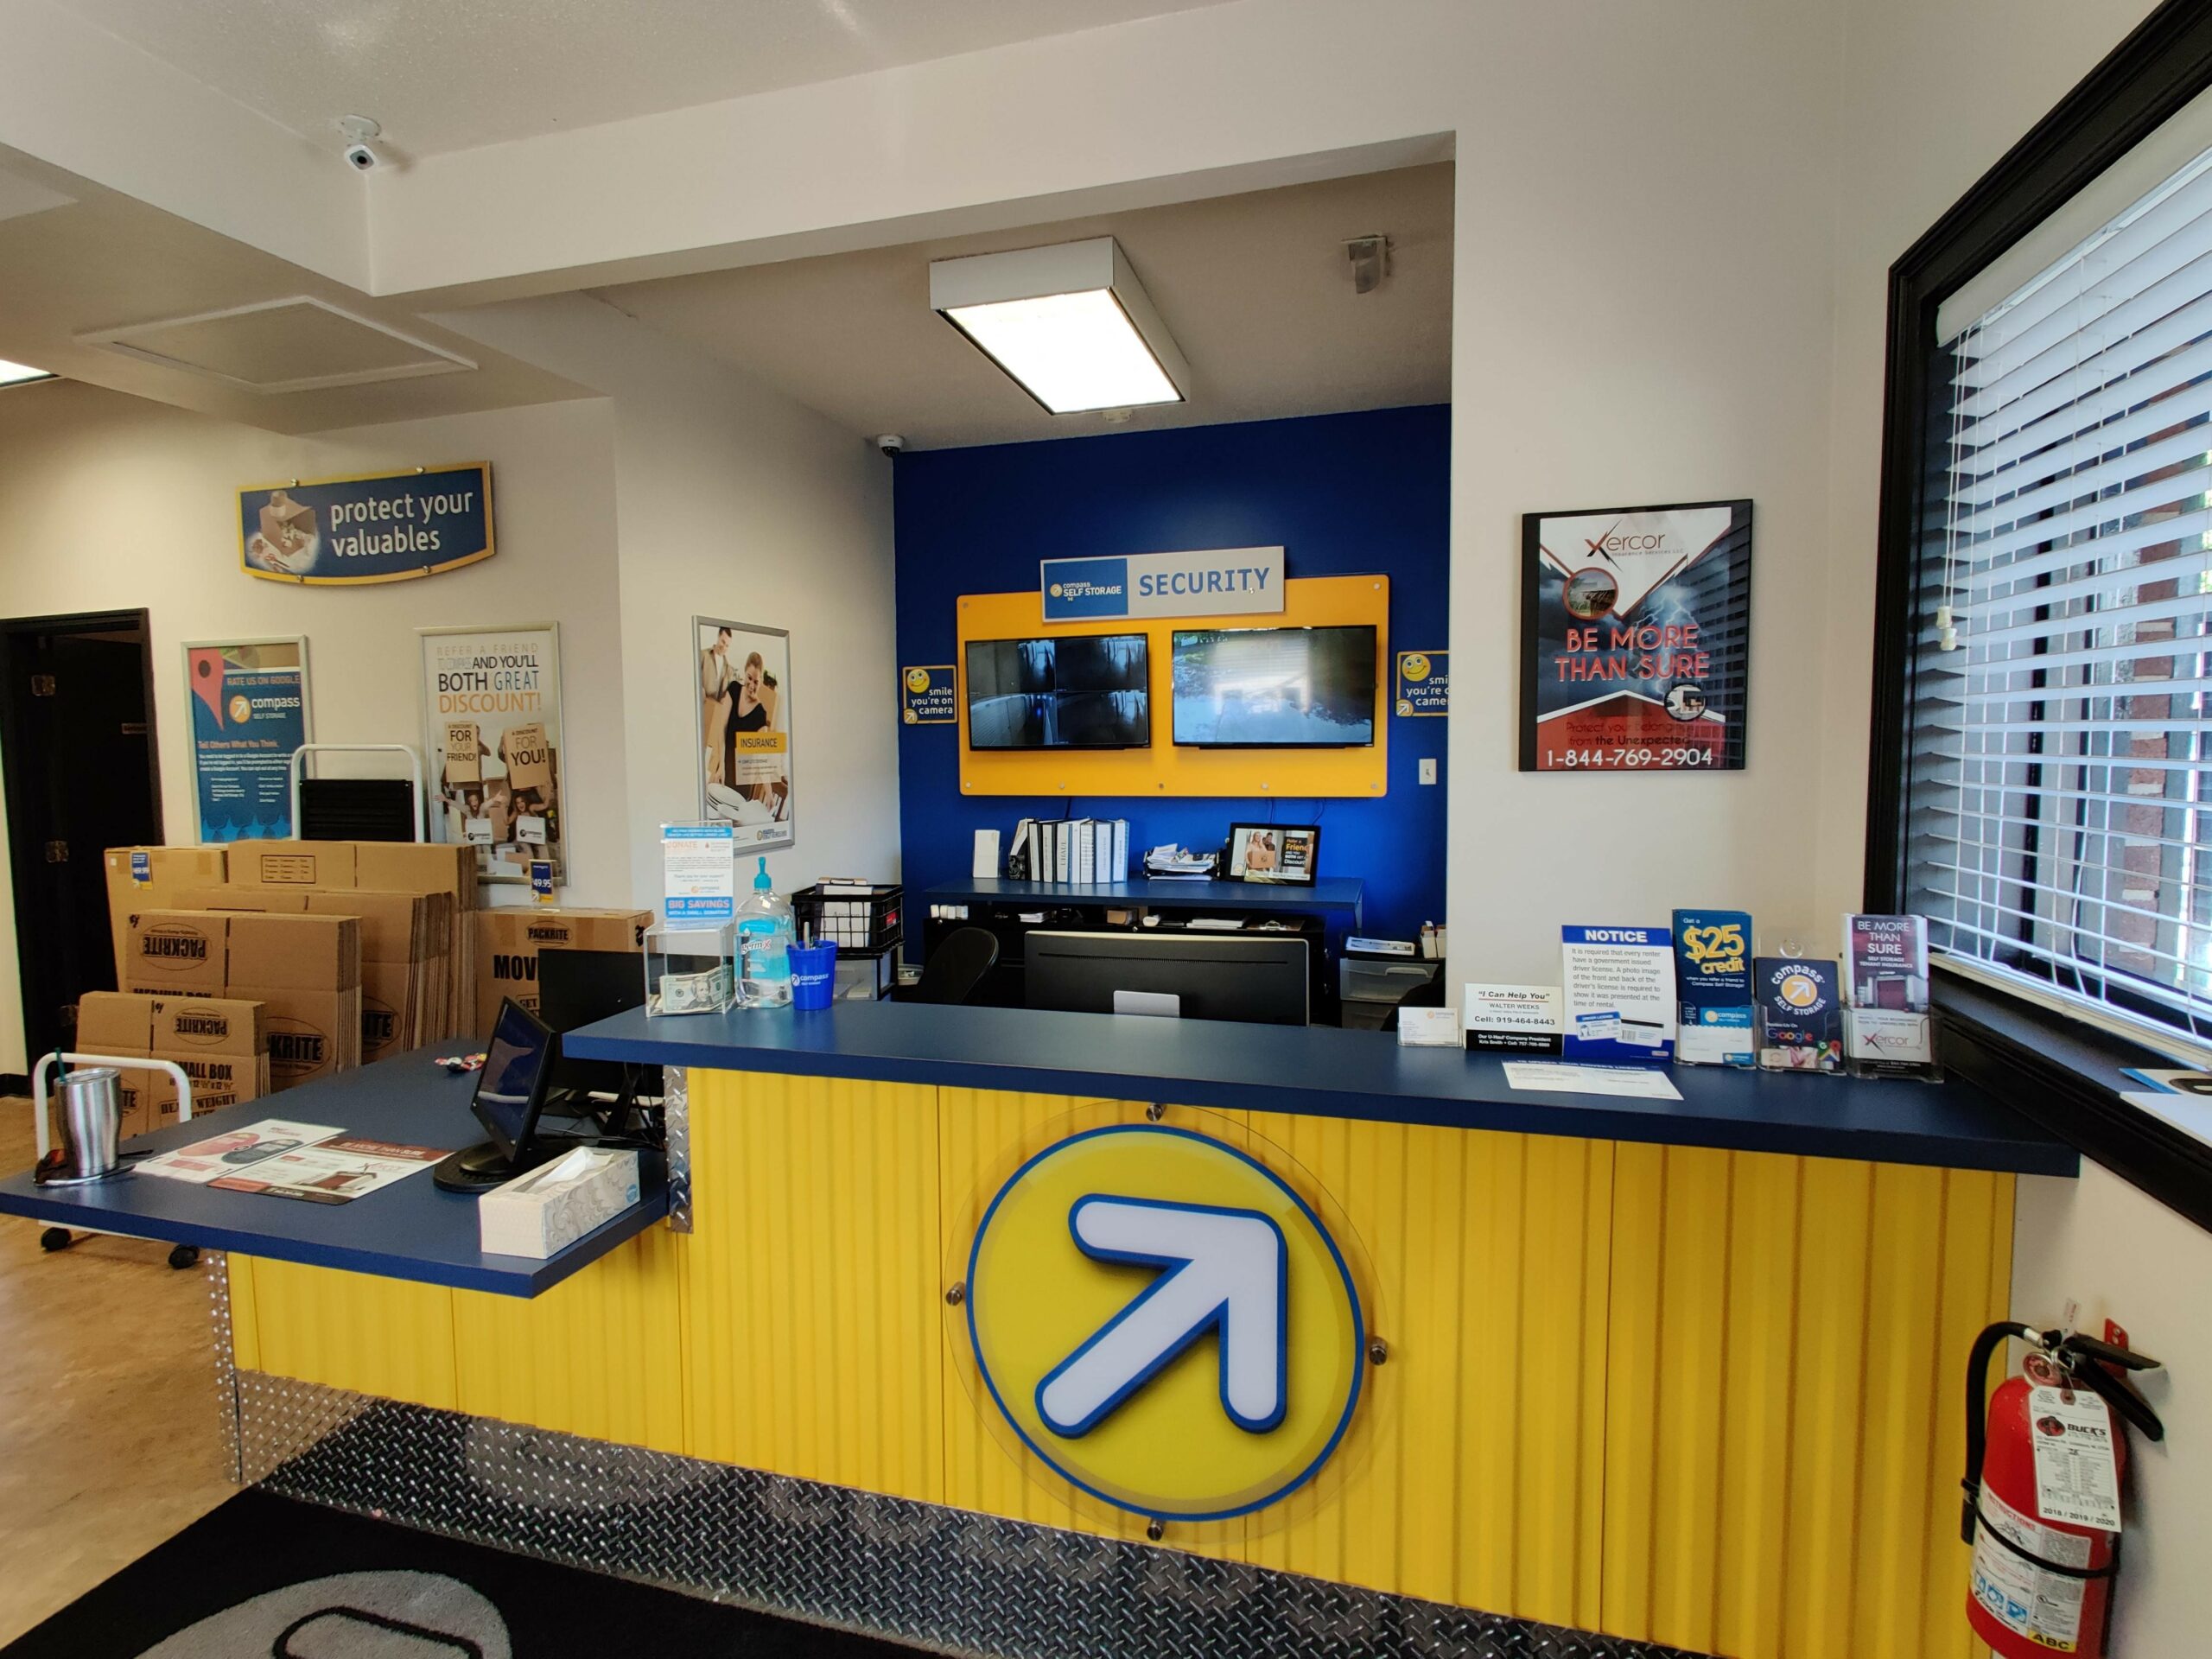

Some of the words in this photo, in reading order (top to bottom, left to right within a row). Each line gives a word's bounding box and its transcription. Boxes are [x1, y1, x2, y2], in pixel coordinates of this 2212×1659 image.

[330, 494, 415, 531] protect
[420, 492, 474, 524] your
[331, 524, 441, 556] valuables
[1585, 518, 1665, 572] Xercor
[1139, 567, 1270, 596] SECURITY
[1085, 586, 1122, 595] STORAGE
[1567, 628, 1599, 652] BE
[1611, 624, 1699, 651] MORE
[473, 656, 497, 669] AND
[499, 655, 538, 668] YOU'LL
[1554, 654, 1626, 683] THAN
[1638, 653, 1711, 680] SURE
[227, 677, 244, 685] RATE
[270, 675, 301, 684] GOOGLE
[439, 672, 487, 691] BOTH
[494, 671, 539, 690] GREAT
[1429, 675, 1448, 684] smi
[1406, 686, 1441, 697] you're
[251, 697, 300, 710] compass
[439, 692, 541, 713] DISCOUNT!
[911, 696, 940, 707] you're
[450, 730, 471, 741] FOR
[516, 736, 537, 748] FOR
[741, 738, 778, 748] INSURANCE
[1595, 736, 1613, 745] the
[511, 748, 546, 766] YOU!
[1548, 748, 1713, 767] 1-844-769-2904
[688, 899, 729, 909] SAVINGS
[1858, 921, 1871, 930] BE
[1873, 922, 1910, 931] MORE
[528, 928, 569, 940] PACKRITE
[1585, 930, 1648, 943] NOTICE
[1869, 932, 1900, 942] THAN
[144, 937, 206, 957] PACKRITE
[1683, 924, 1745, 963] $25
[1867, 944, 1902, 954] SURE
[494, 955, 538, 981] MOV
[1700, 957, 1745, 974] credit
[799, 973, 829, 982] compass
[1771, 965, 1825, 984] compass
[1774, 995, 1793, 1012] SELF
[1794, 998, 1826, 1015] STORAGE
[175, 1018, 227, 1035] PACKRITE
[1766, 1028, 1813, 1043] Google
[1862, 1028, 1909, 1055] Xercor
[270, 1034, 322, 1062] KRITE
[209, 1064, 232, 1080] BOX
[197, 1094, 237, 1108] WEIGHT
[2068, 1424, 2106, 1436] BUCKS
[2069, 1512, 2088, 1521] 2019
[2095, 1517, 2115, 1526] 2020
[2033, 1633, 2069, 1649] ABC
